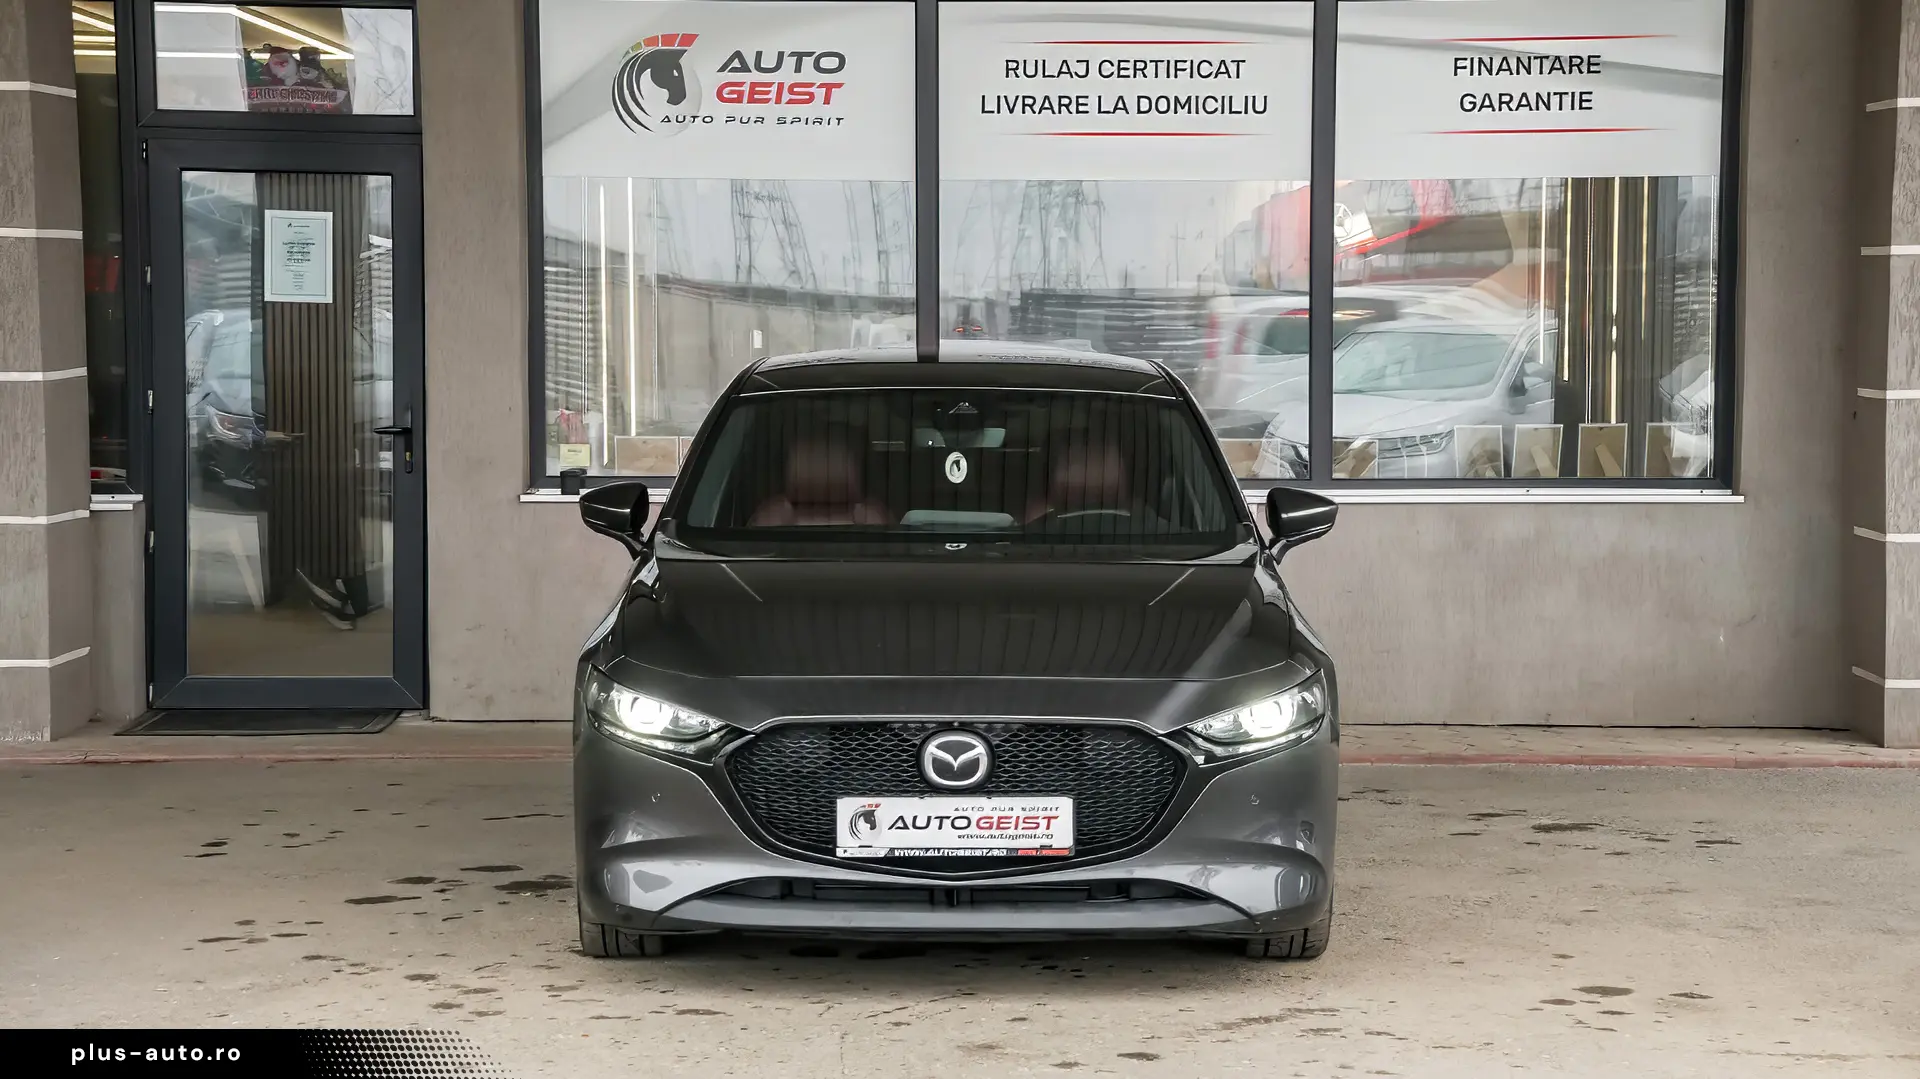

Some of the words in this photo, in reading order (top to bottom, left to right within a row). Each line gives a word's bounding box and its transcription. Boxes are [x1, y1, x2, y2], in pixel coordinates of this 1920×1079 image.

[716, 50, 846, 74] AUTO
[1004, 59, 1090, 79] RULAJ
[1098, 59, 1246, 79] CERTIFICAT
[1453, 54, 1602, 77] FINANTARE
[715, 81, 846, 106] GEIST
[980, 94, 1090, 115] LIVRARE
[1097, 95, 1129, 115] LA
[1136, 94, 1268, 115] DOMICILIU
[1459, 91, 1594, 113] GARANTIE
[660, 114, 714, 125] AUTO
[725, 115, 765, 126] PUR
[775, 116, 845, 127] SPIRIT
